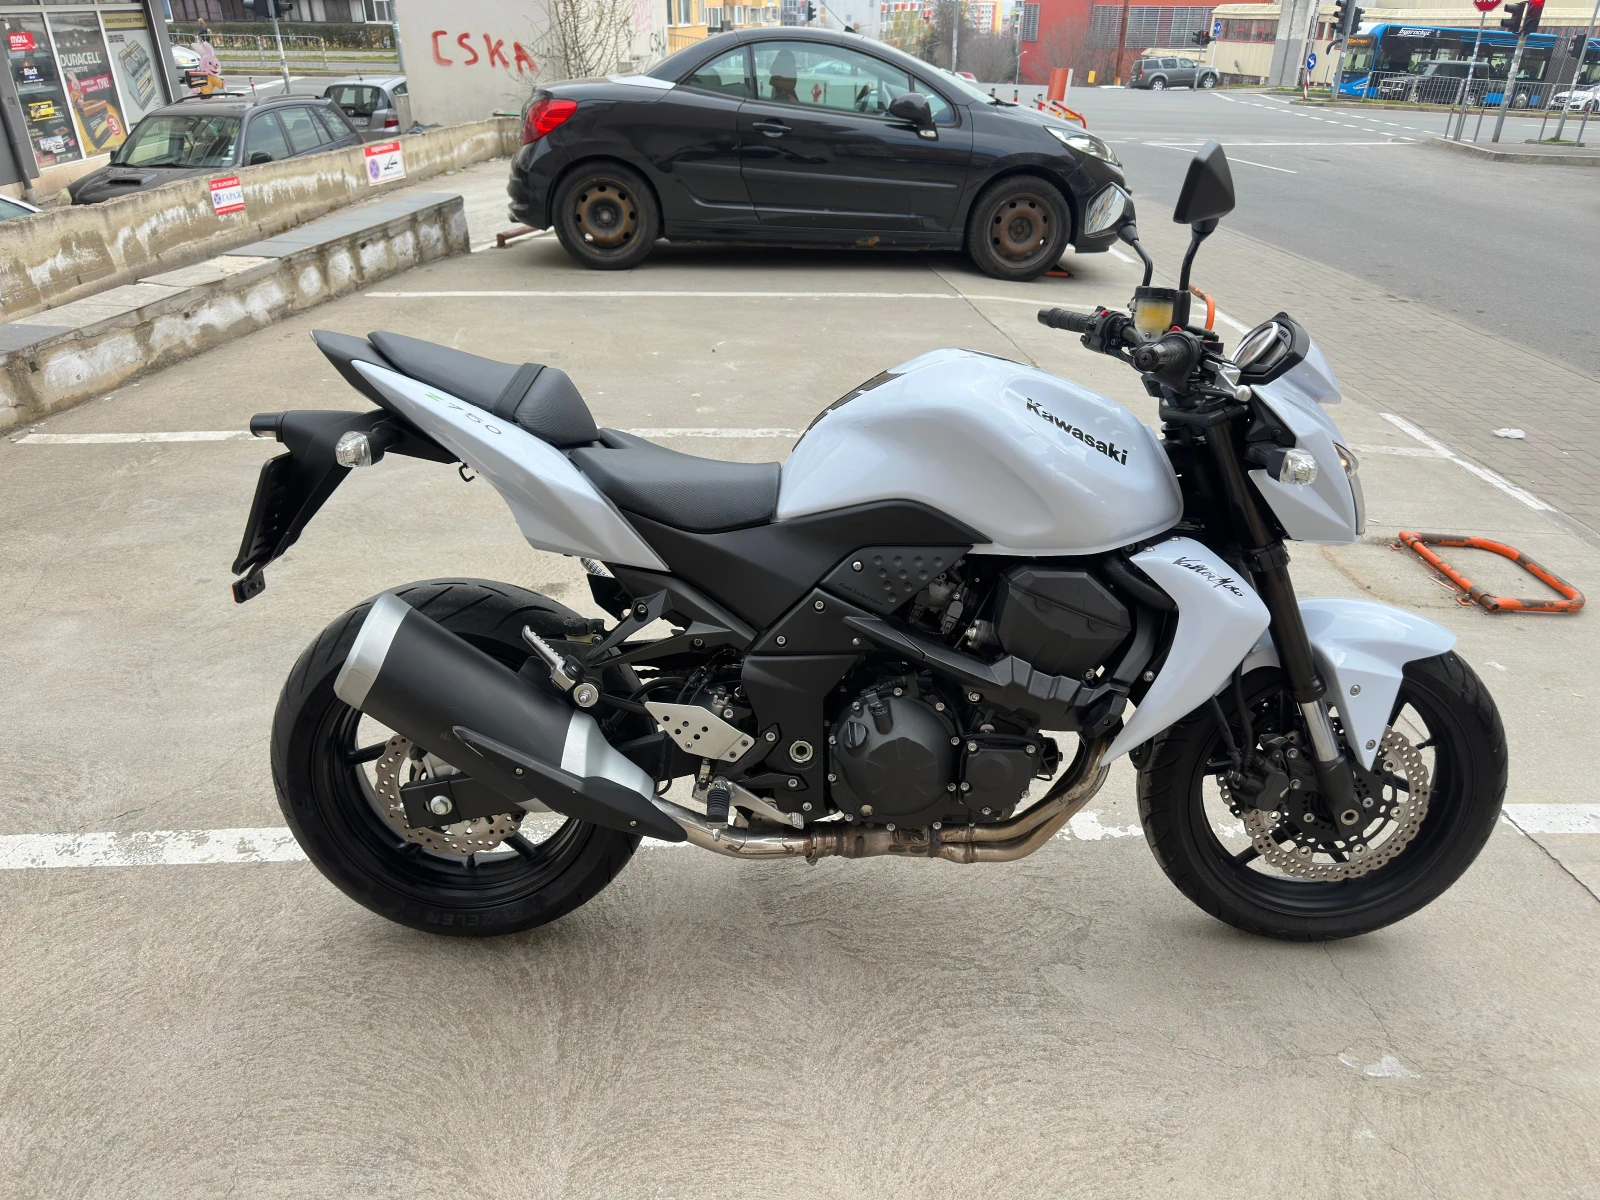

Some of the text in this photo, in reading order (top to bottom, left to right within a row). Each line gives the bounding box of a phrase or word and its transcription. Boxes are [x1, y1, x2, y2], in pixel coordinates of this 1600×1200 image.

[59, 51, 102, 67] DURACELL
[431, 30, 539, 75] CSKA
[221, 190, 243, 203] ГАРАЖ
[1025, 397, 1129, 466] Kawasaki
